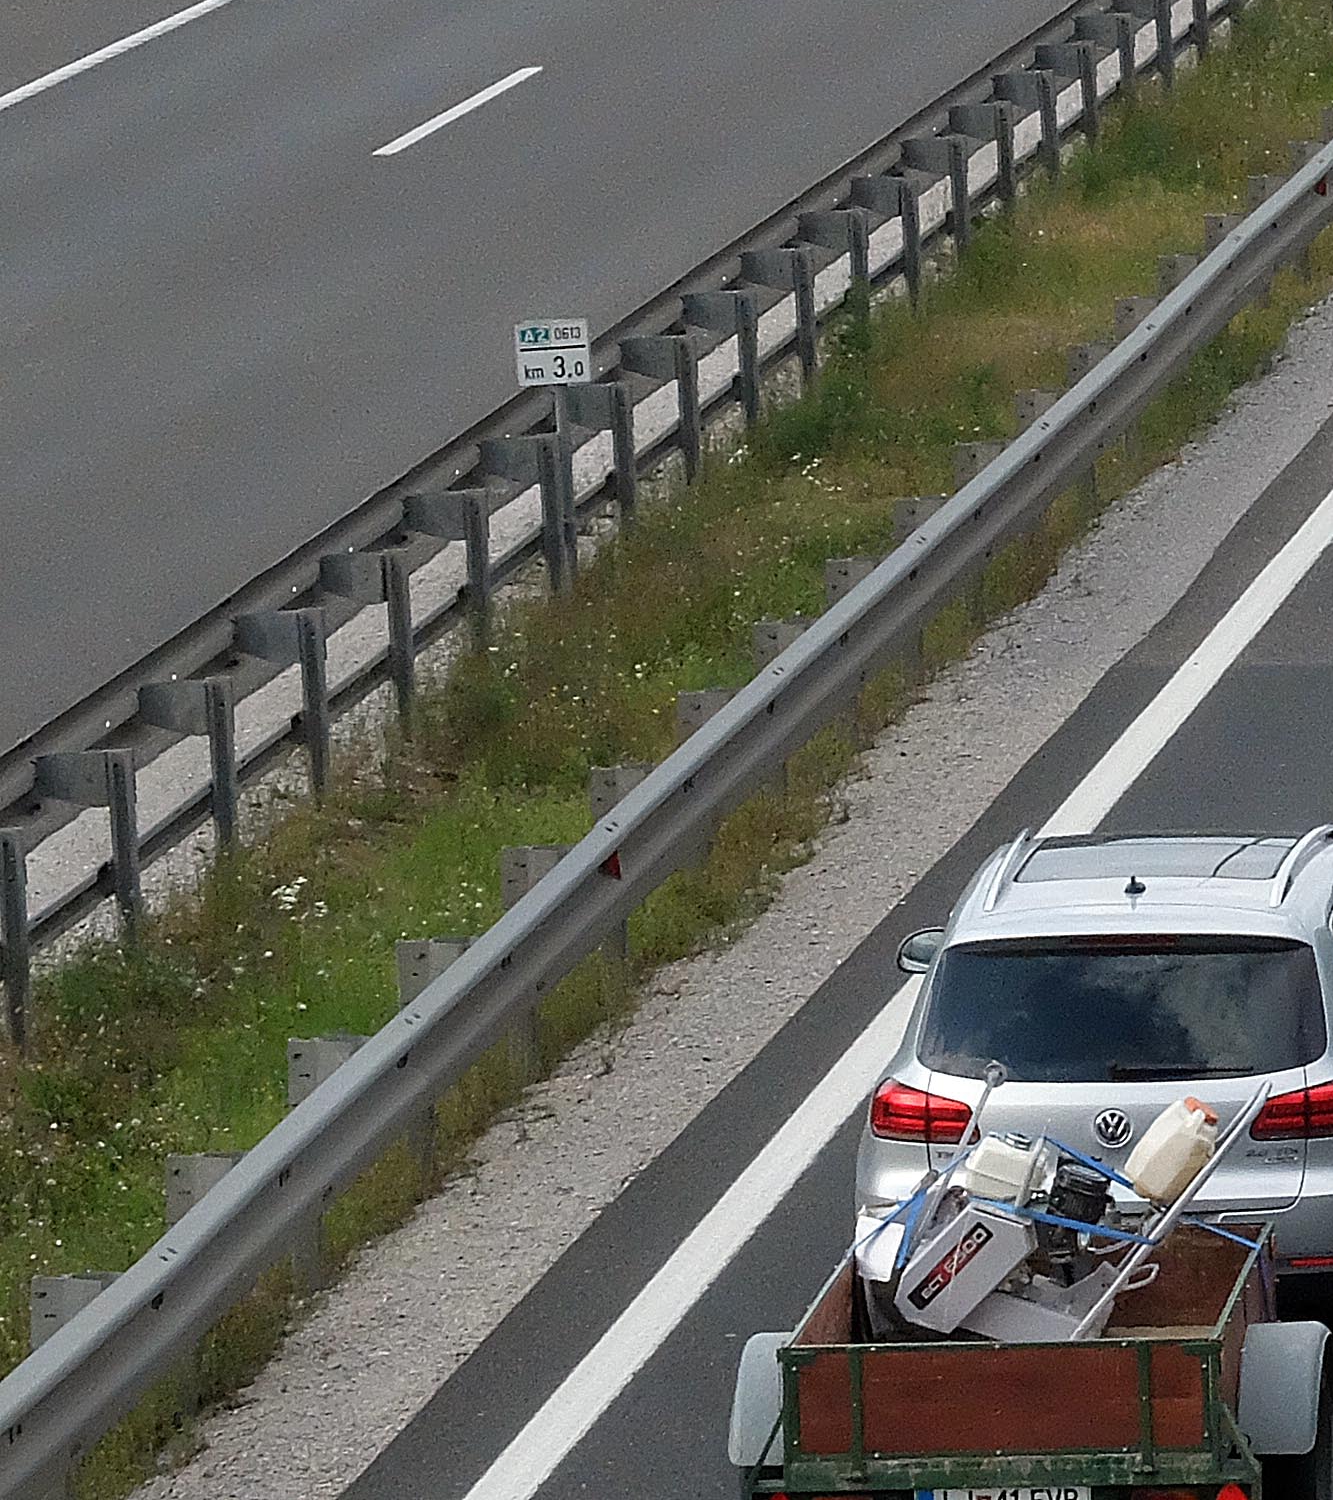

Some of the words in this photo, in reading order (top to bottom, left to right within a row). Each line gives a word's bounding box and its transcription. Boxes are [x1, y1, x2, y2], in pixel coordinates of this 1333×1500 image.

[524, 329, 547, 342] A2
[553, 326, 581, 340] 0613
[524, 364, 545, 380] km
[553, 355, 584, 379] 3.0
